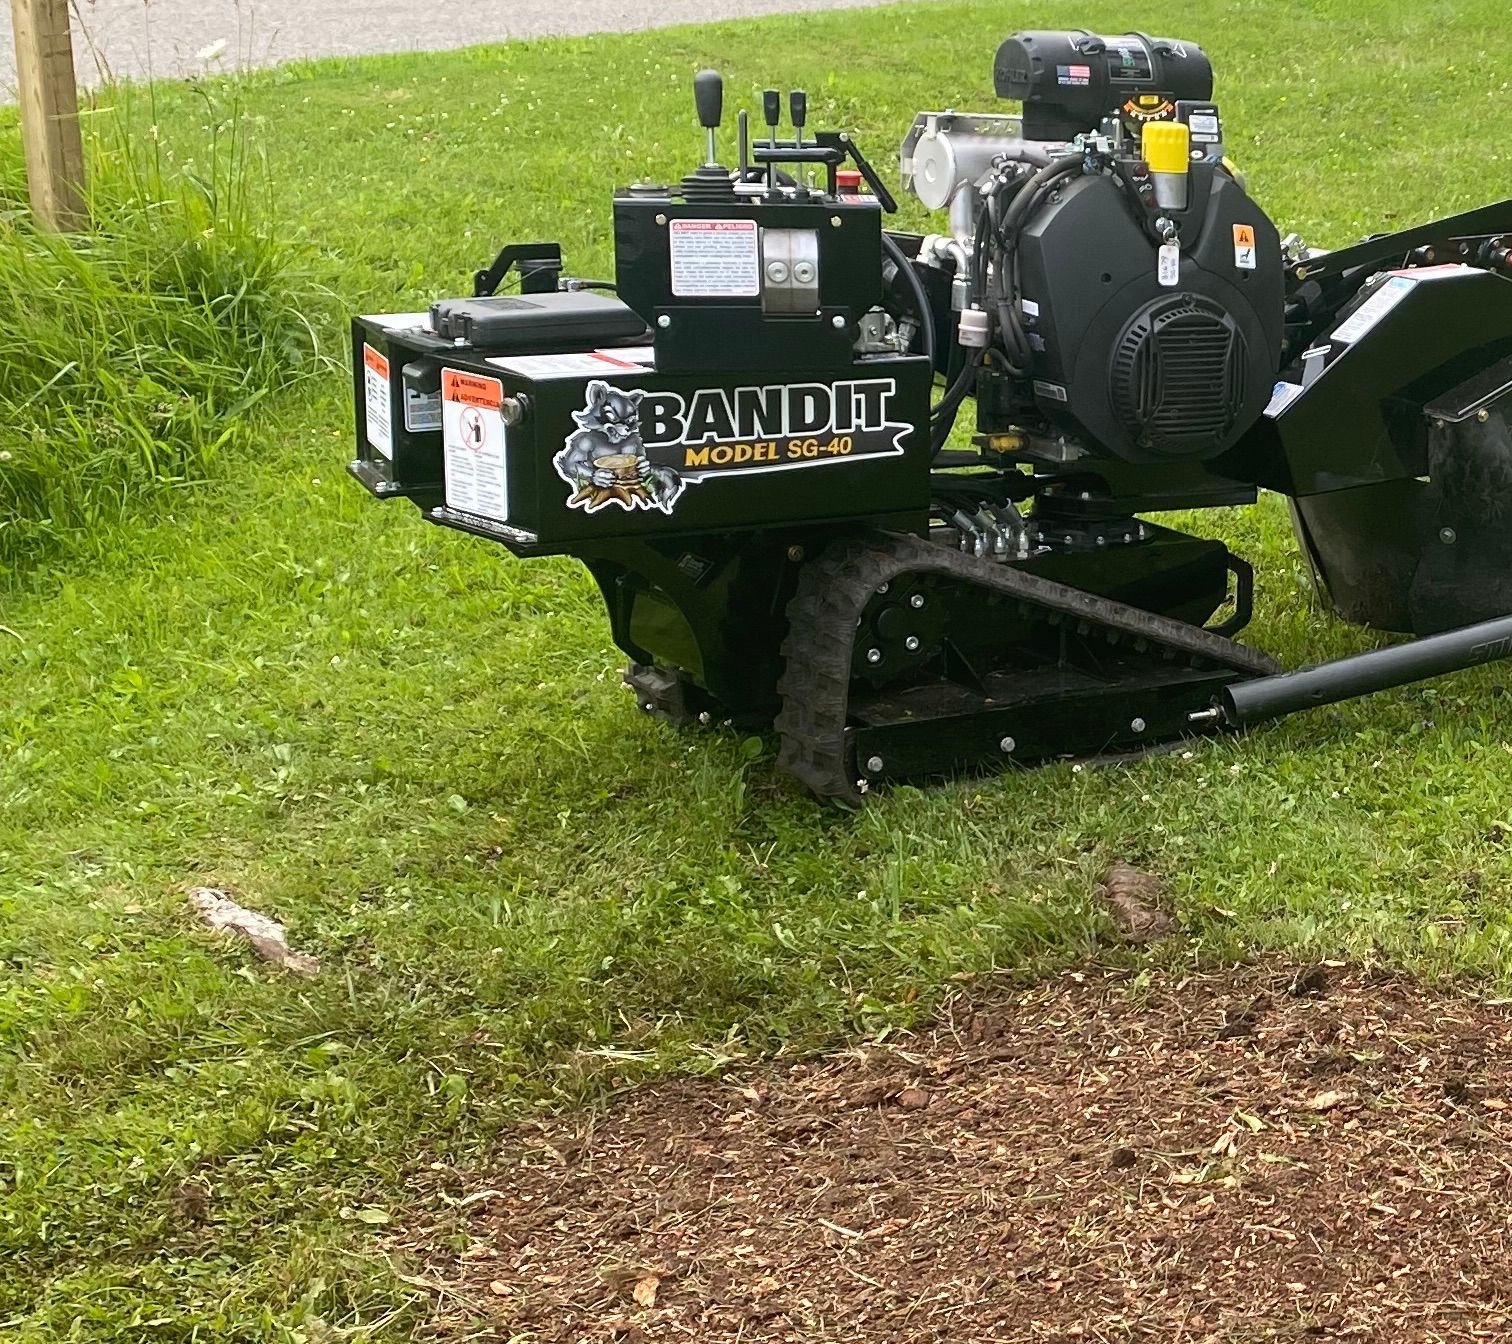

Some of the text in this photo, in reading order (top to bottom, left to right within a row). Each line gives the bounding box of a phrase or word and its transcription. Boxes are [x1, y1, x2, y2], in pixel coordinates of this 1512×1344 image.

[638, 378, 896, 447] BANDIT
[684, 437, 852, 467] MODEL SG-40
